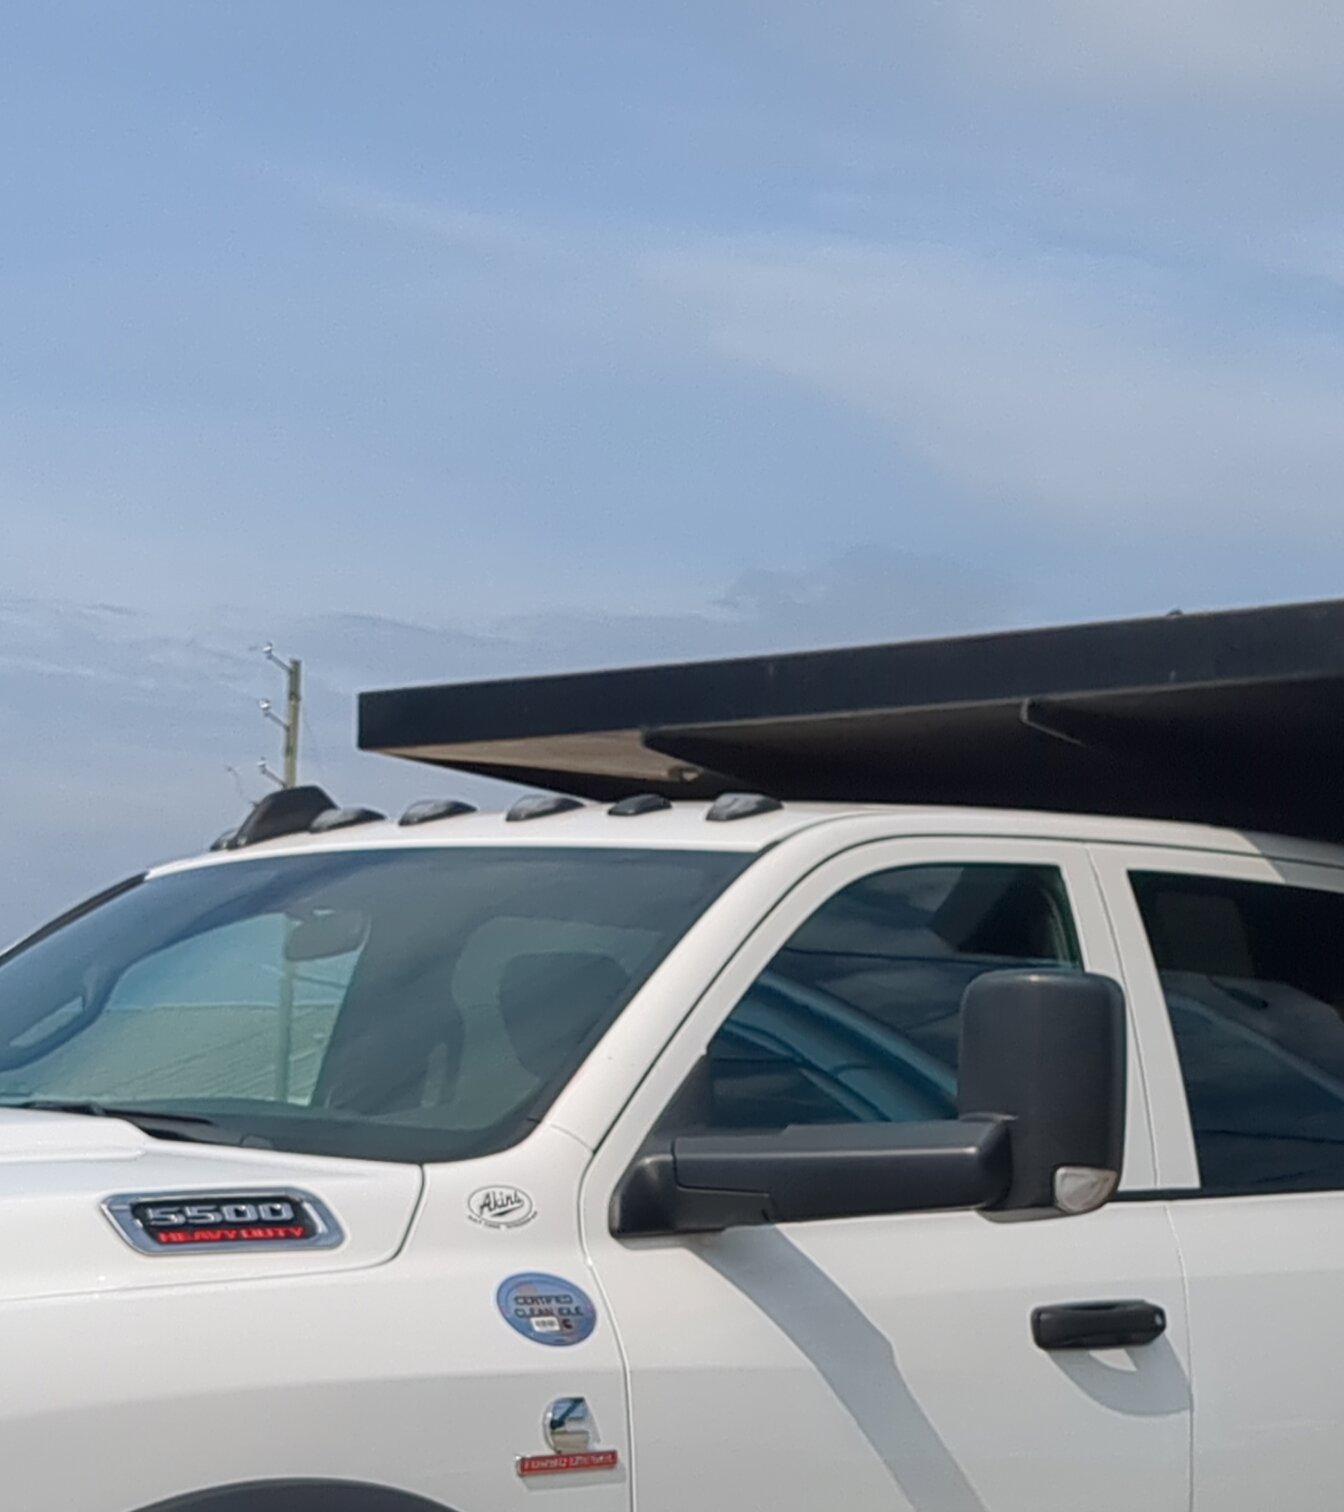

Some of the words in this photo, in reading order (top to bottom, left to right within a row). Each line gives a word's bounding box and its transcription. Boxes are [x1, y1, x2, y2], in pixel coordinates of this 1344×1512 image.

[147, 1203, 294, 1226] 5500
[159, 1229, 236, 1243] HEAVY
[241, 1227, 304, 1240] DUTY
